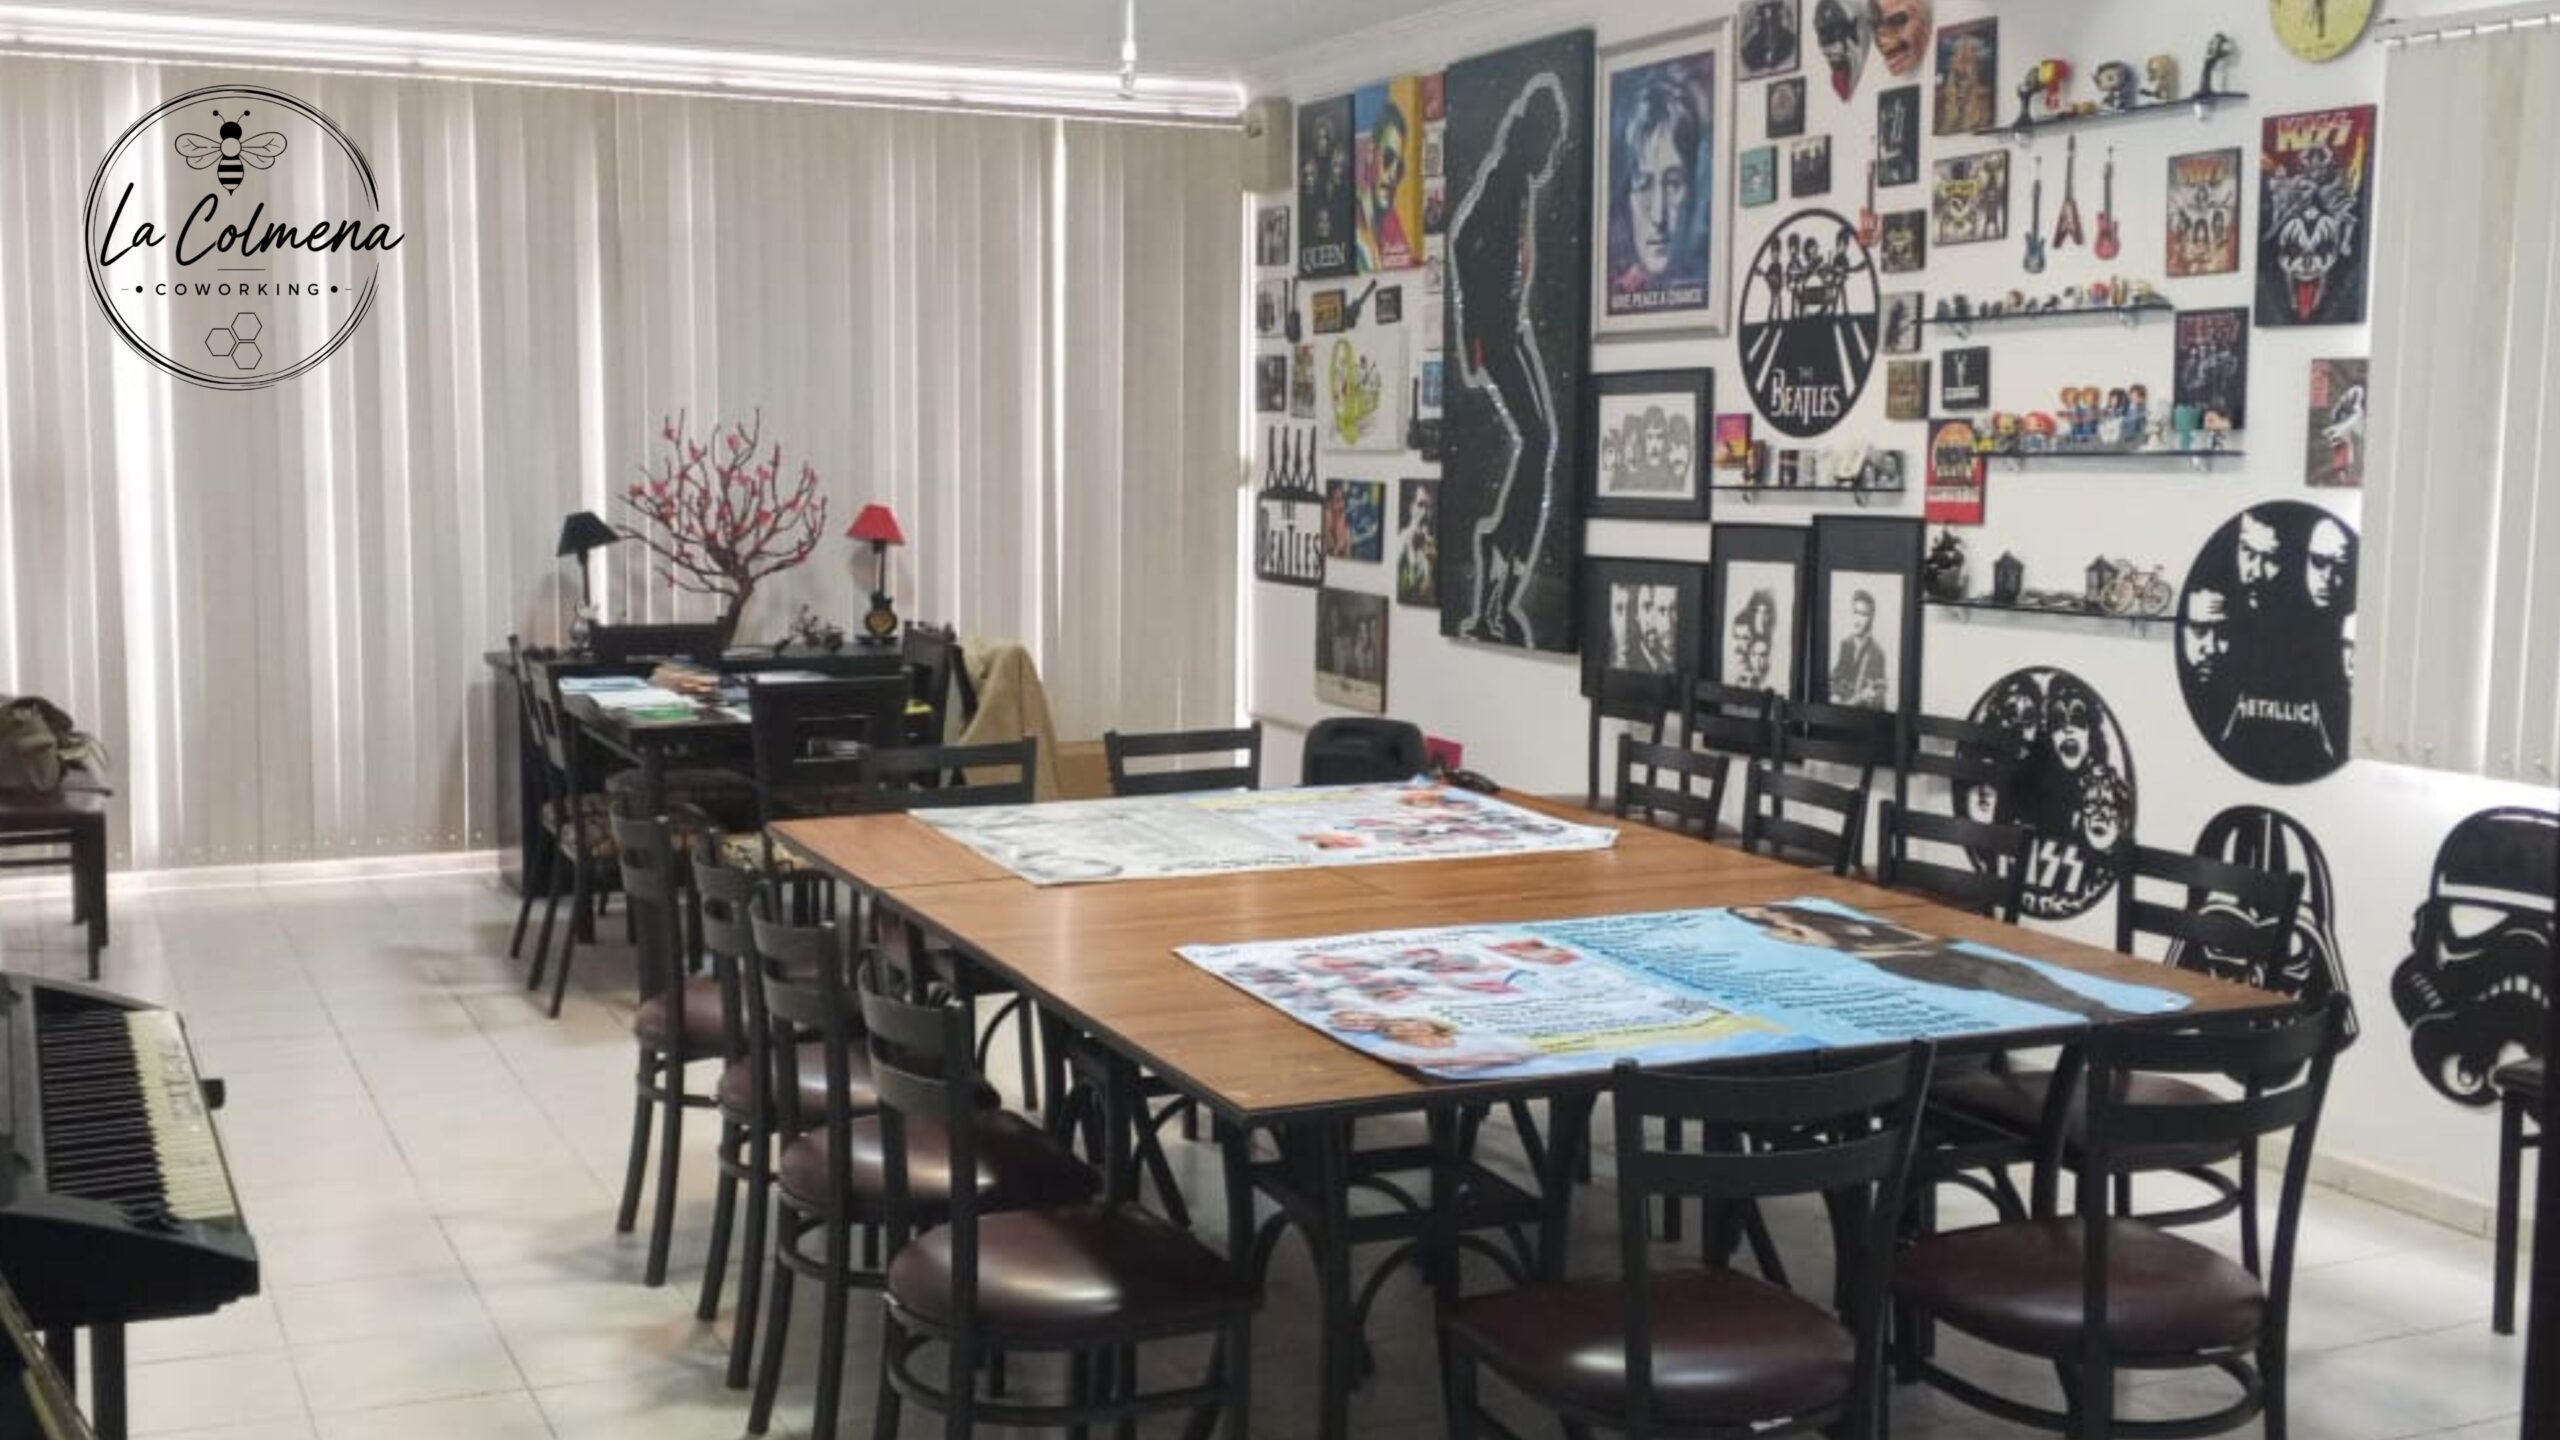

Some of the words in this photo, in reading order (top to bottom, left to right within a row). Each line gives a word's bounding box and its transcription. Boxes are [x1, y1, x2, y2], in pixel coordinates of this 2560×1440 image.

[1303, 242, 1346, 272] QUEEN
[1770, 368, 1841, 425] BEATLES
[2220, 692, 2335, 758] METALLICA
